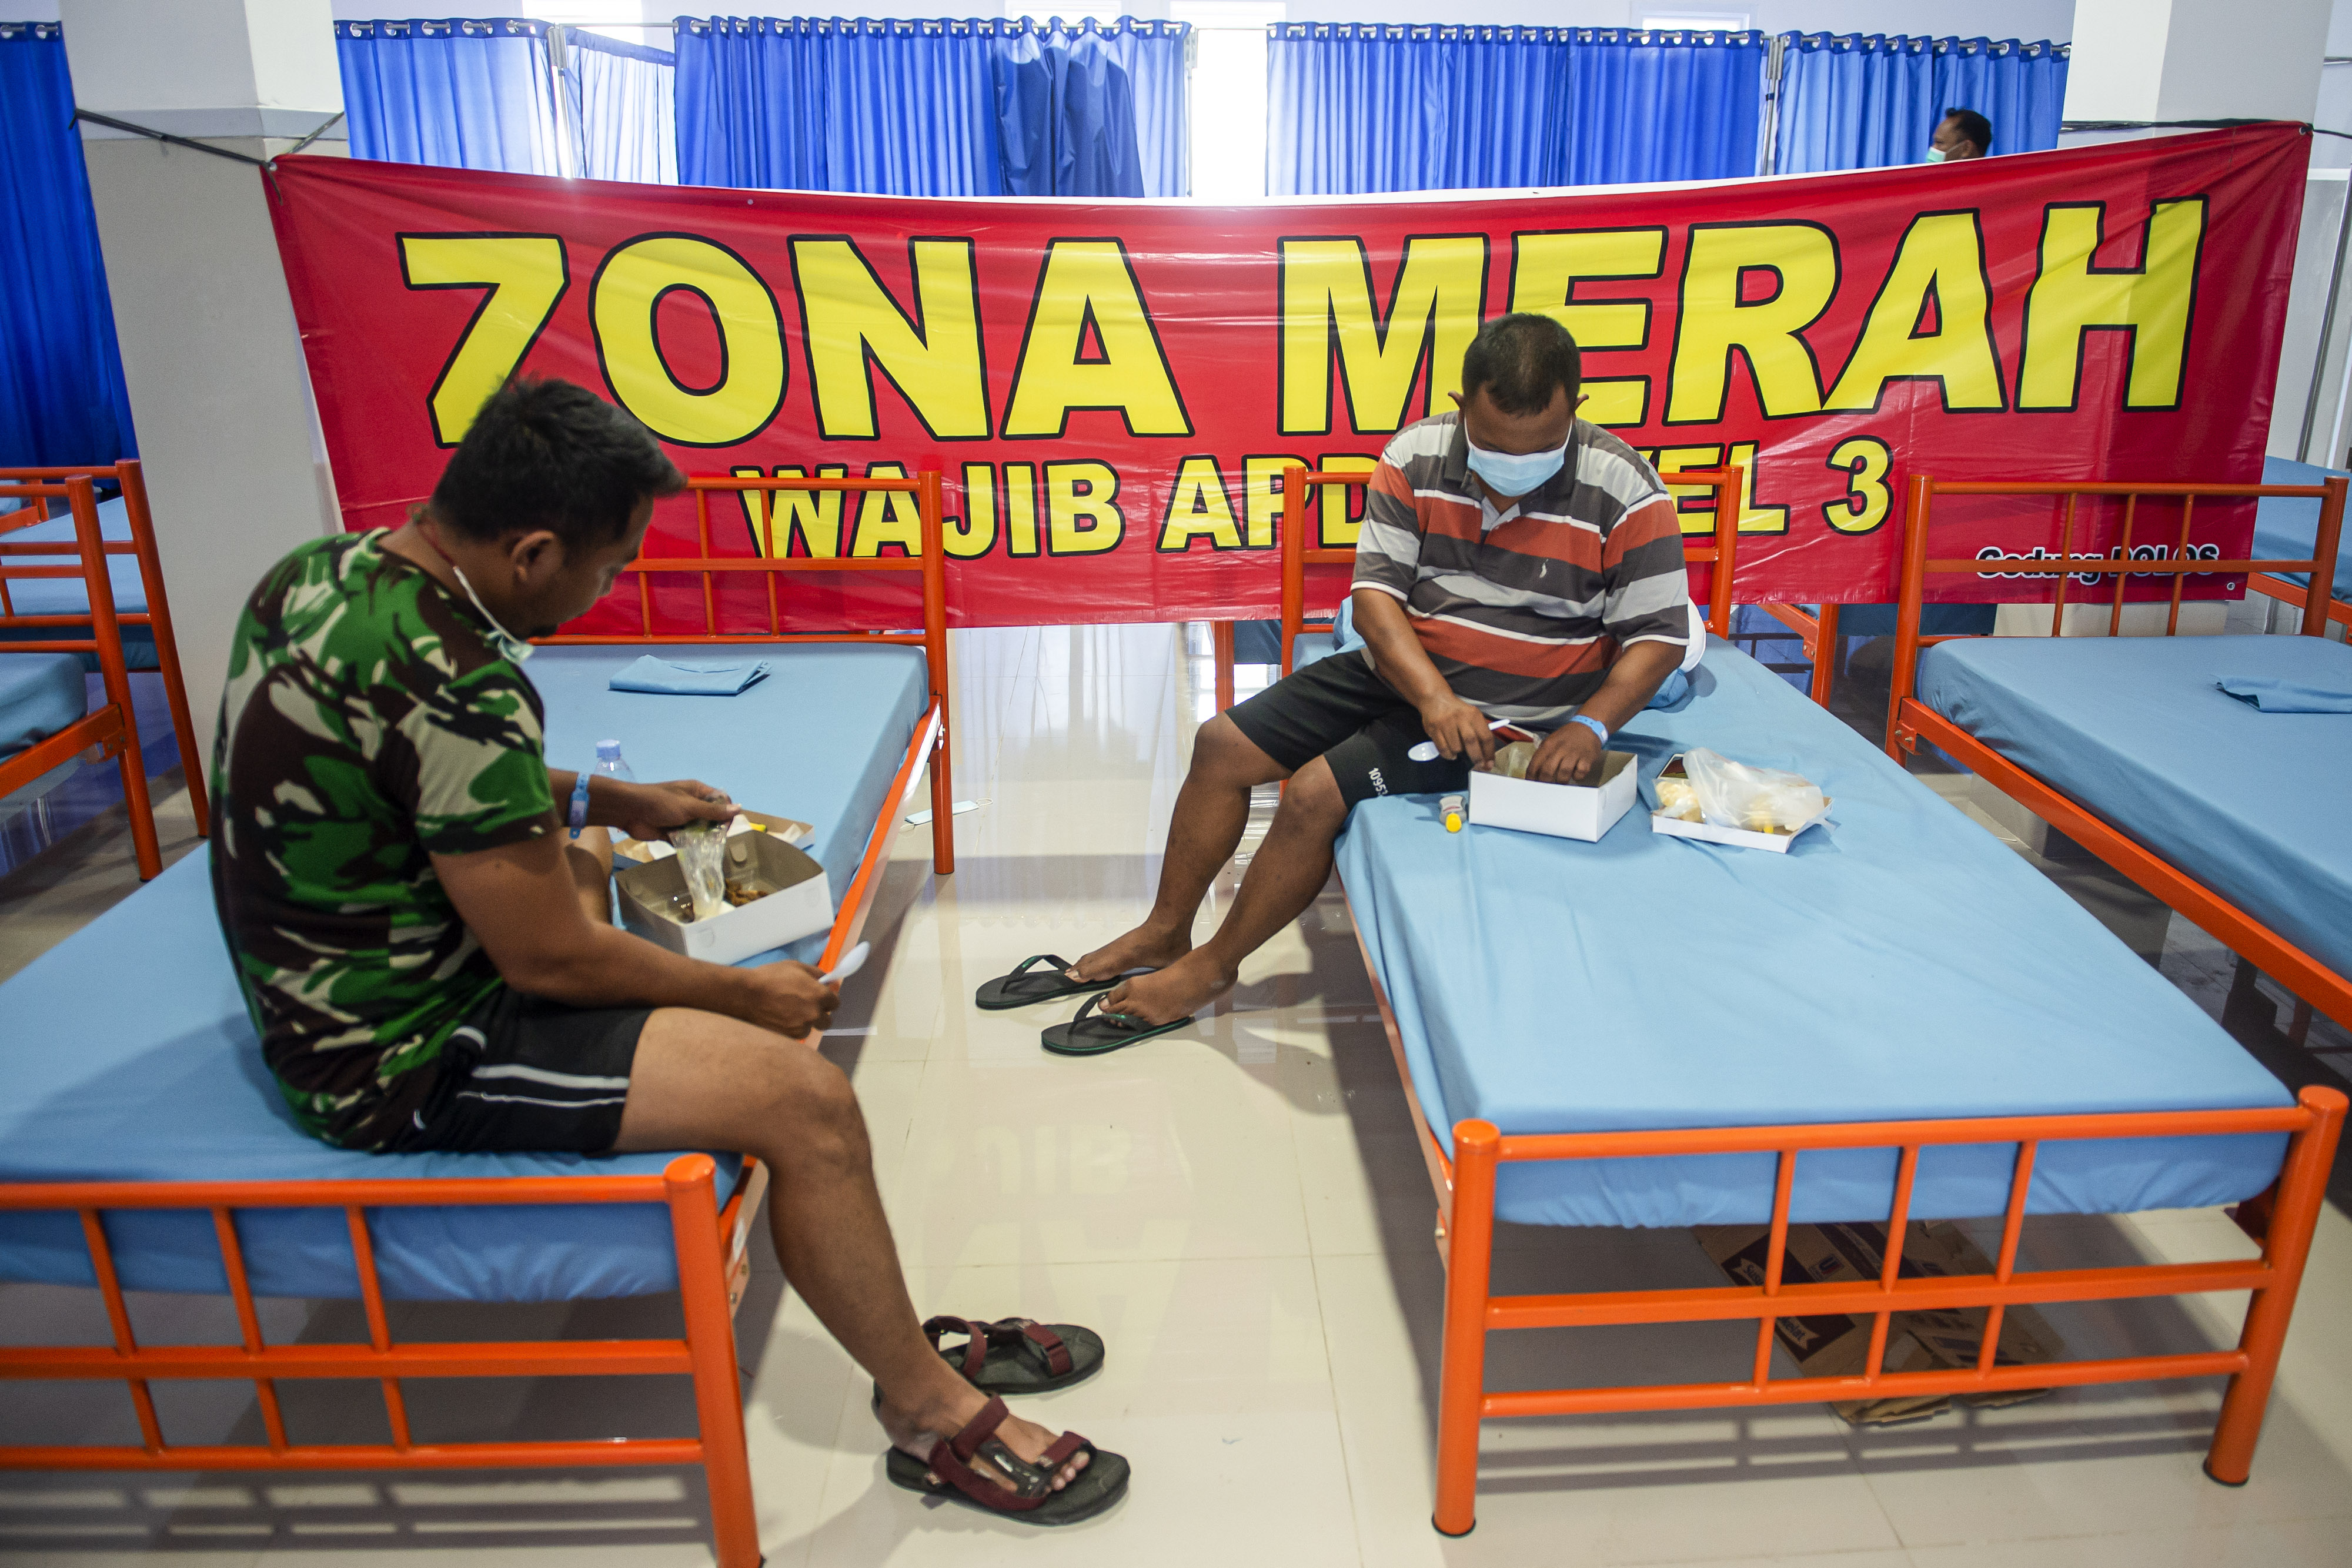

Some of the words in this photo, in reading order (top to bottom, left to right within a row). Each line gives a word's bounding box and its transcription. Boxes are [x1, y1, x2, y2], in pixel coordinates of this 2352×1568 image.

[396, 232, 1195, 448] ZONA
[1277, 194, 2209, 436] MERAH
[730, 458, 1126, 560] WAJIB
[1155, 453, 1381, 554] APD
[1821, 434, 1895, 536] 3
